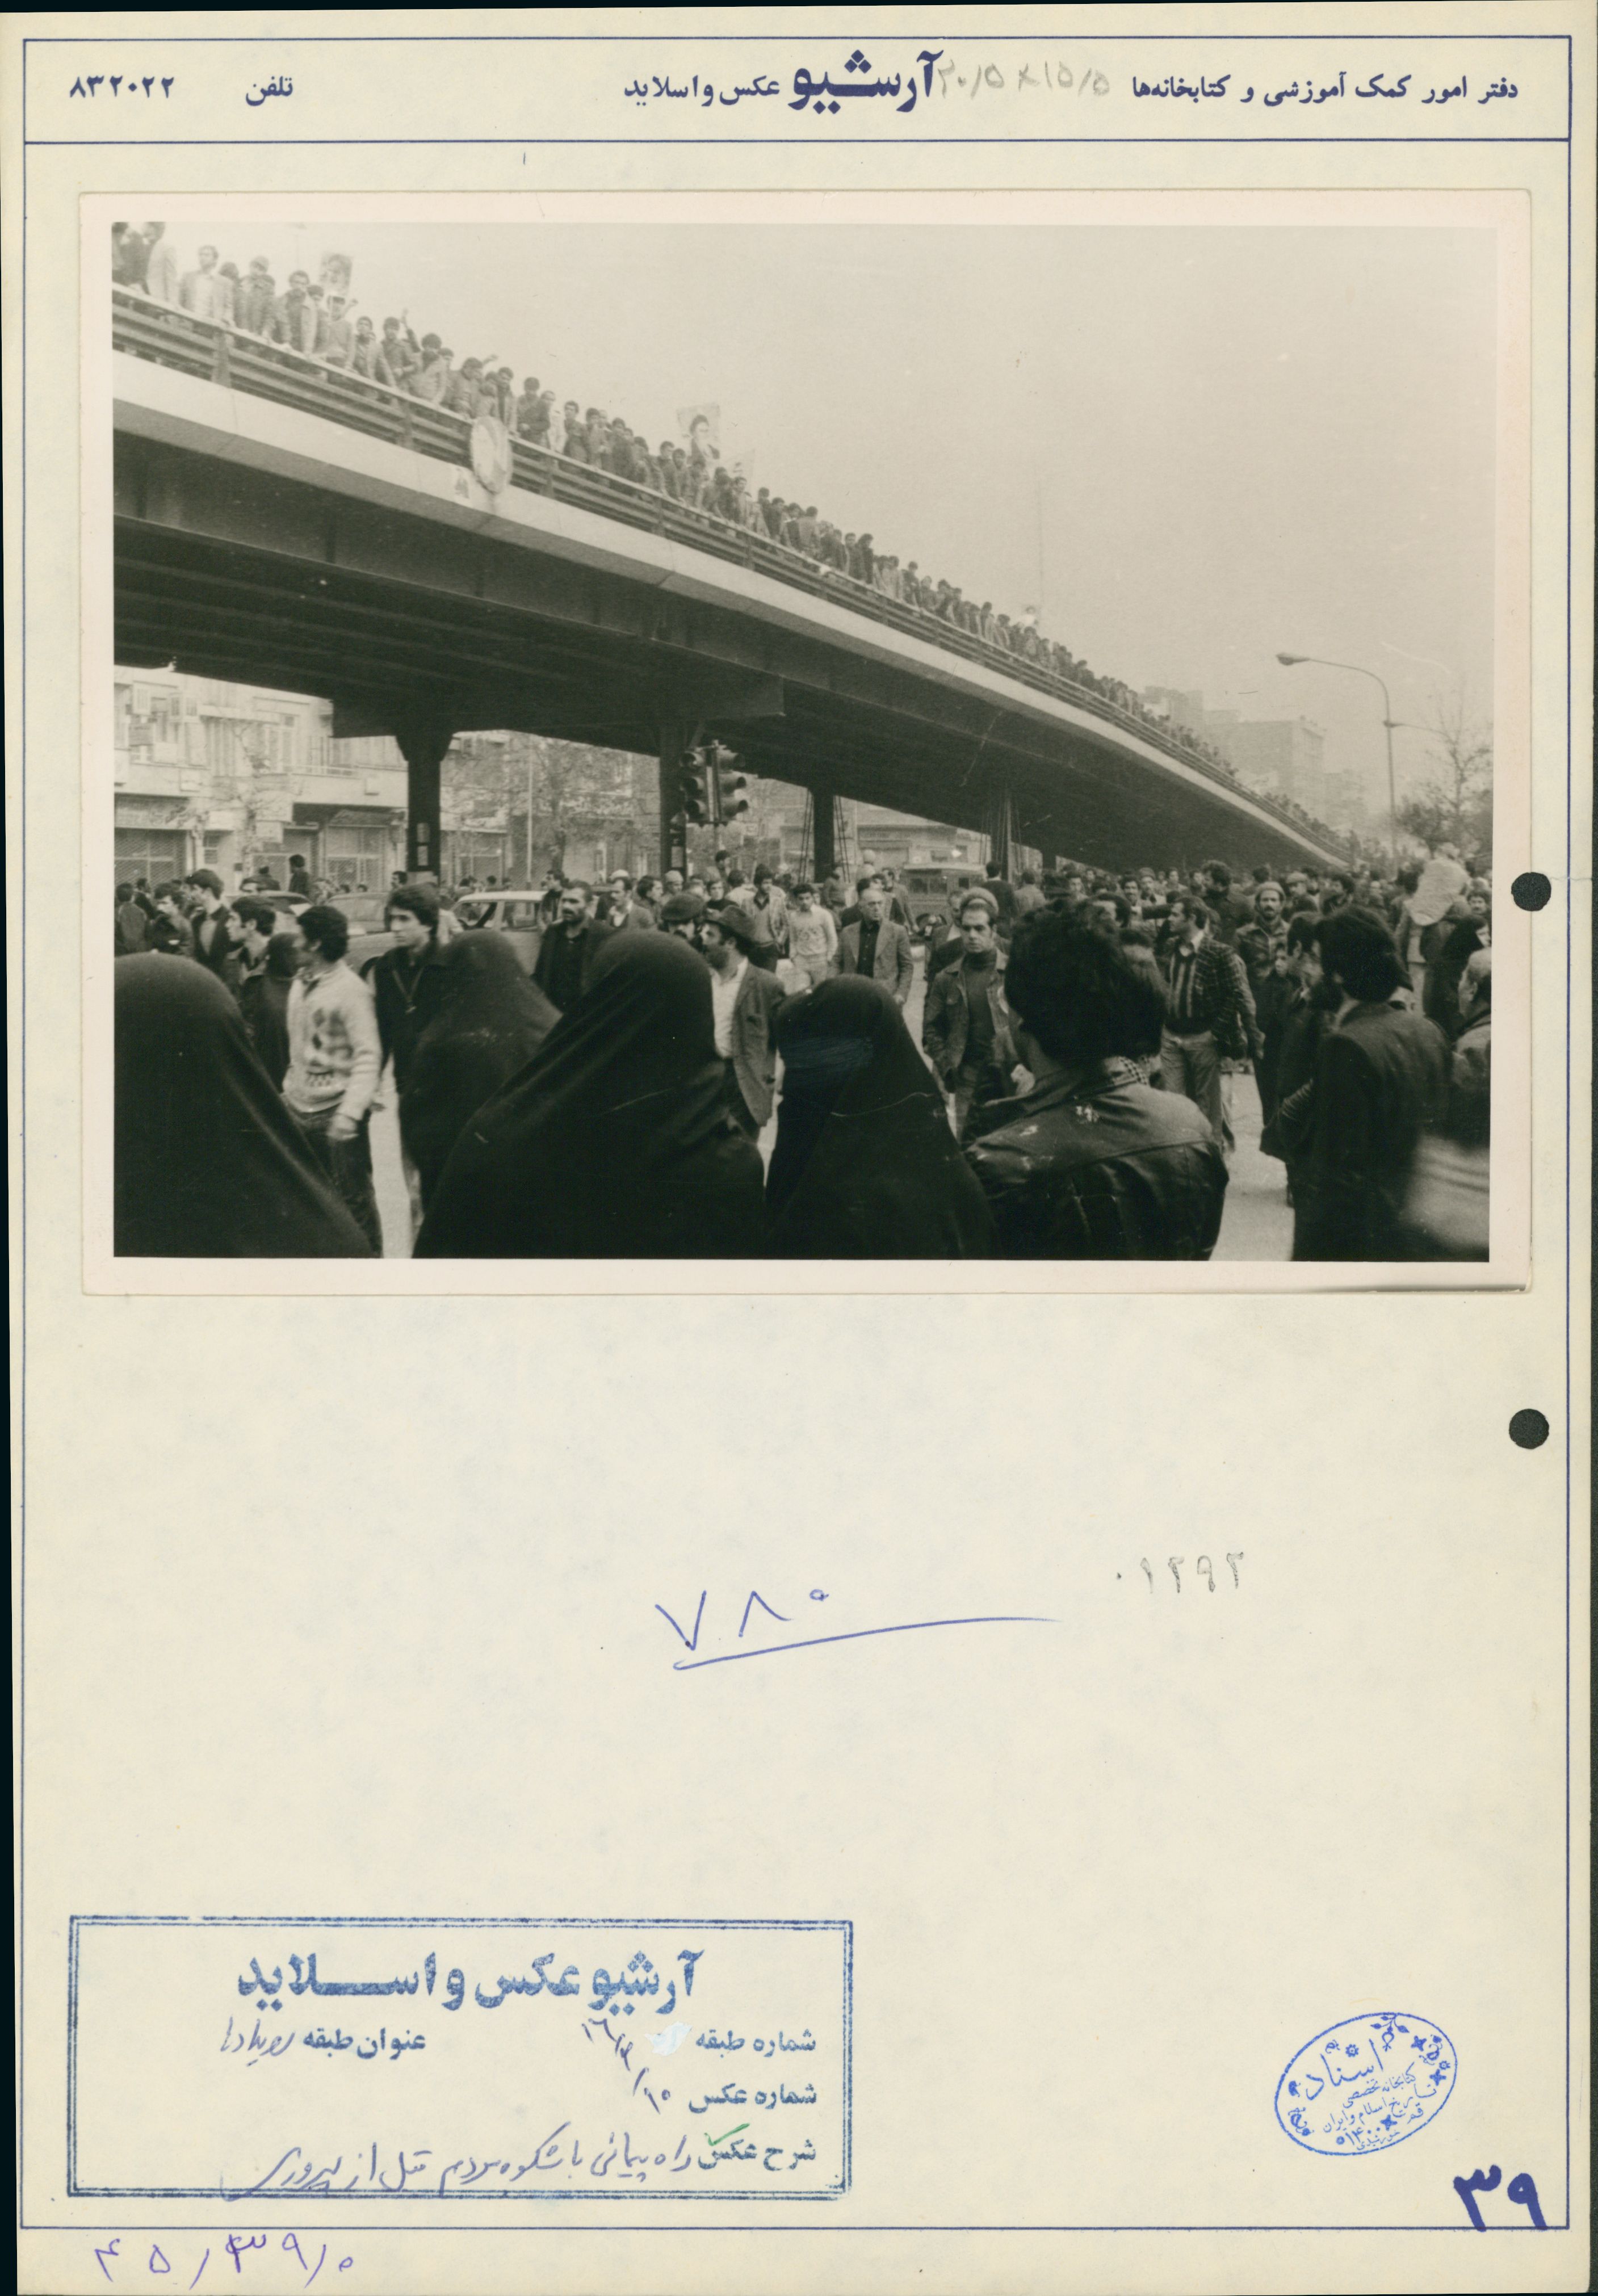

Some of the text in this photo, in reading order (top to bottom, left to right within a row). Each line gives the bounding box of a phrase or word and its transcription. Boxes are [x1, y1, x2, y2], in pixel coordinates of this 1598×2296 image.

[69, 74, 175, 99] ۸۳۲۰۲۲
[245, 75, 294, 107] تلفن
[719, 74, 781, 106] عکس
[787, 49, 949, 115] آرشیو
[1239, 86, 1255, 104] و
[1263, 70, 1348, 108] آموزشی
[1354, 73, 1412, 99] کمک
[1421, 74, 1468, 104] امور
[1477, 77, 1519, 105] دفتر
[237, 1951, 438, 2012] اسلاید
[474, 1952, 581, 2009] عکس
[587, 1949, 705, 2017] آرشیو
[302, 2026, 426, 2061] عنوان طبقه
[695, 2028, 816, 2059] شماره طبقه
[1306, 2038, 1383, 2101] اسناد
[1343, 2061, 1416, 2109] کتابخانه تخصصی
[687, 2082, 817, 2114] شماره عکس
[697, 2138, 817, 2173] شرح عکس
[1453, 2164, 1549, 2233] ۳۹
